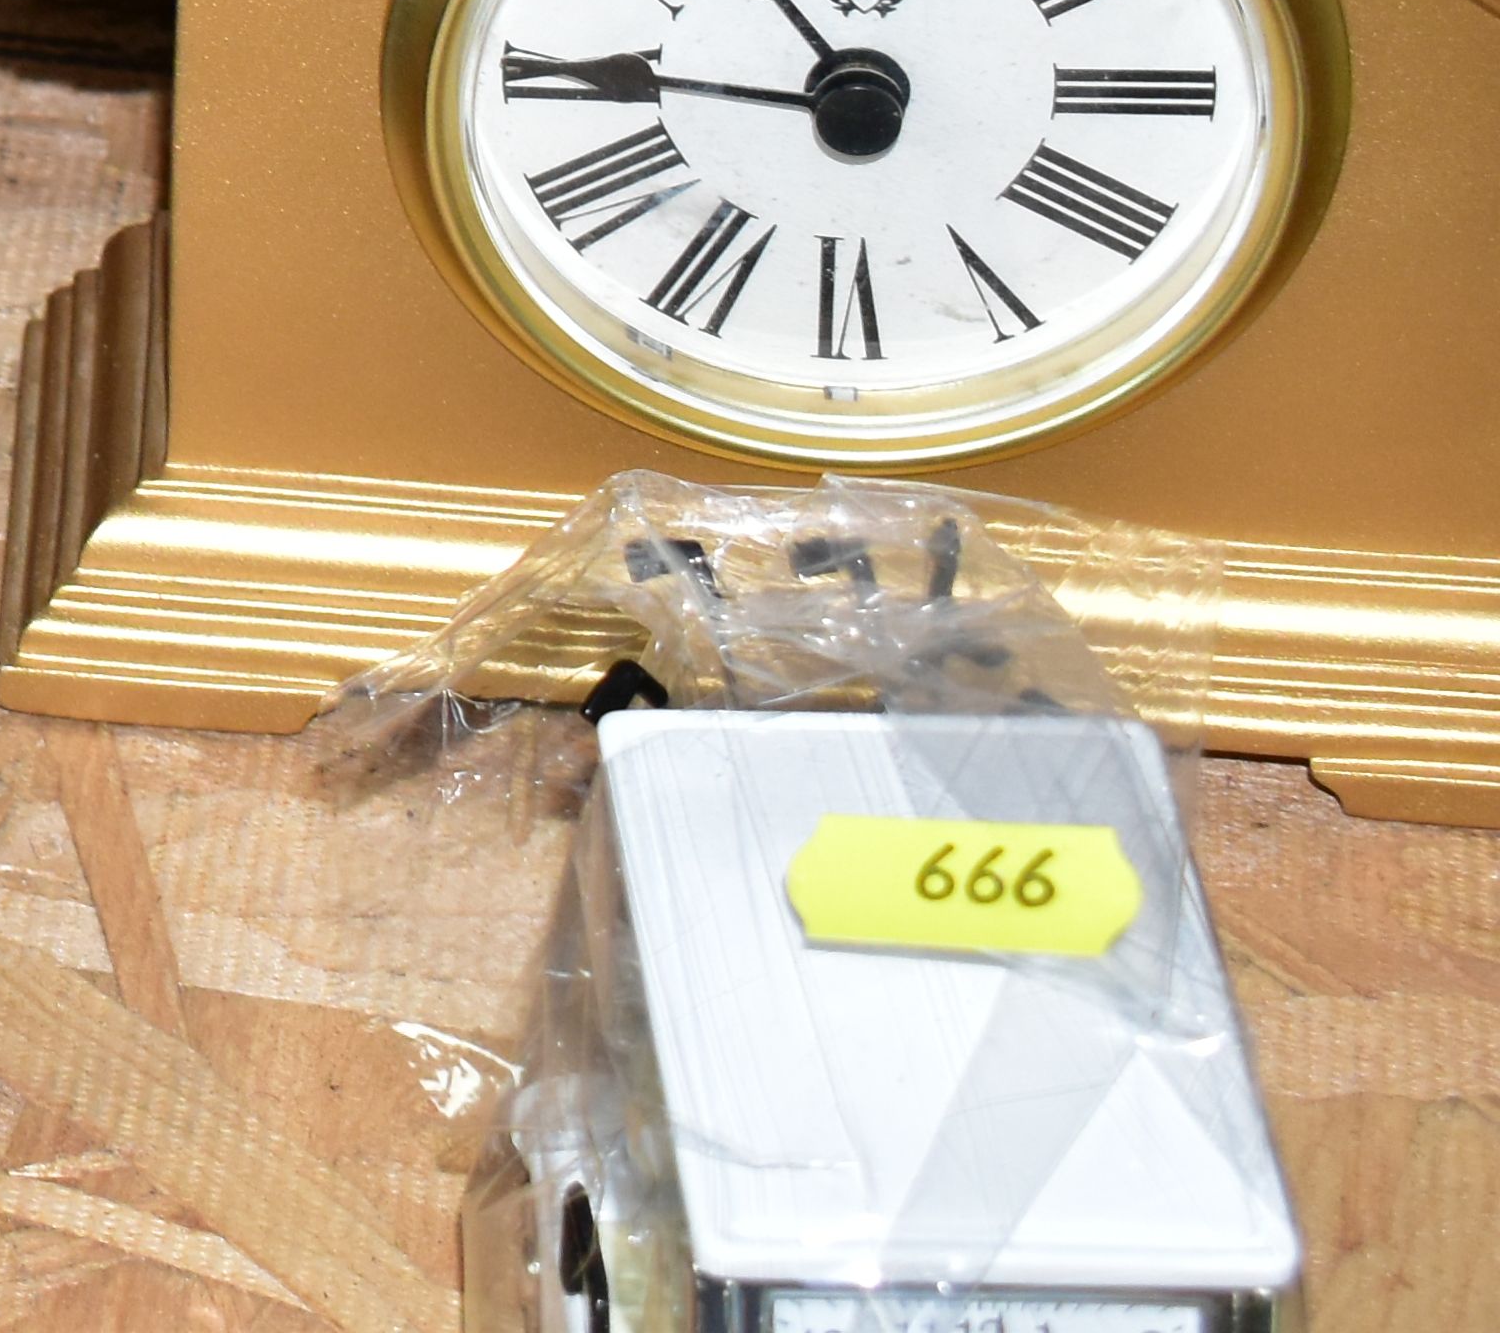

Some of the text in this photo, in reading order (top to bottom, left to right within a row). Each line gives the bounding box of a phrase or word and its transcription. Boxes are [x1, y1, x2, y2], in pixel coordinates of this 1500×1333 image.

[1053, 63, 1218, 123] III
[524, 117, 702, 256] VIII
[996, 139, 1181, 265] IIII
[638, 199, 779, 339] VII
[811, 234, 888, 362] VI
[946, 223, 1046, 346] V
[914, 842, 1058, 909] 666
